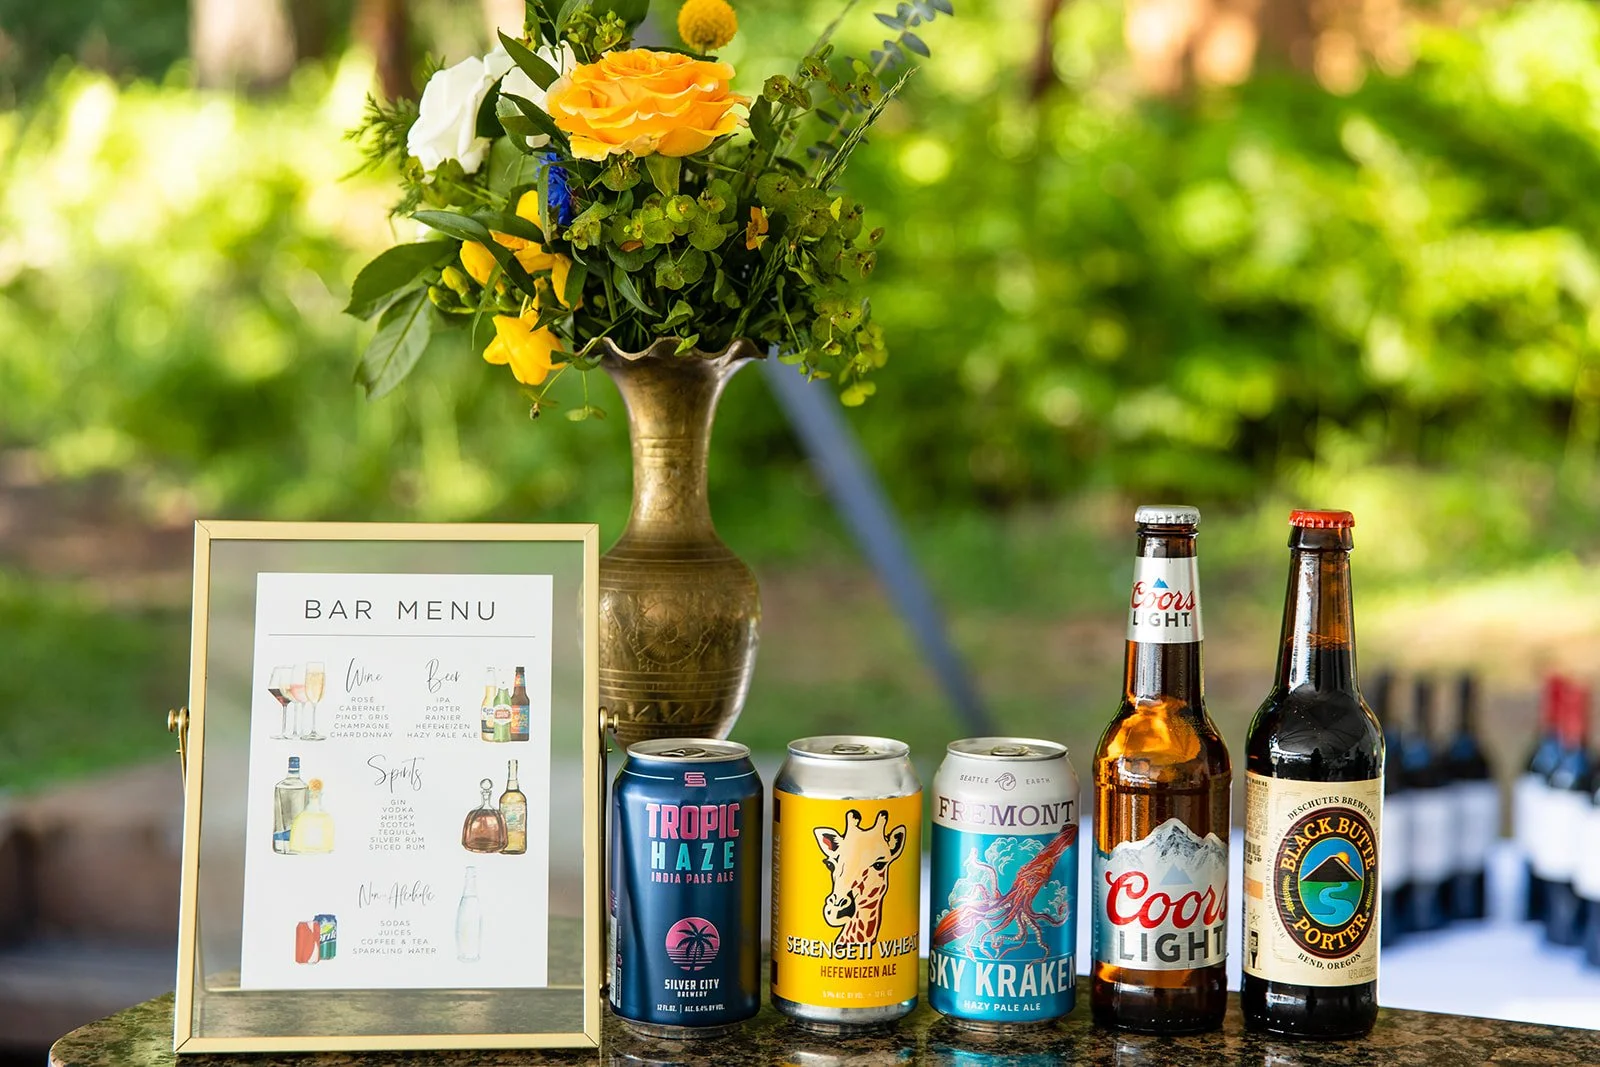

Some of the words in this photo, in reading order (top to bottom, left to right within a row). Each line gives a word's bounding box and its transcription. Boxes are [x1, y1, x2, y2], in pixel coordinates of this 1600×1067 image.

[304, 599, 373, 620] BAR
[397, 600, 496, 621] MENU
[1131, 581, 1196, 611] Coors
[1132, 611, 1191, 628] LIGHT
[345, 657, 383, 693] Wine
[425, 658, 461, 694] Beer
[367, 754, 425, 794] Spirits
[959, 774, 989, 784] SEATTLE
[645, 803, 741, 840] TROPIC
[938, 796, 1074, 827] FREMONT
[1287, 796, 1340, 821] DESCHUTES
[651, 841, 735, 871] HAZE
[1280, 817, 1335, 873] BLACK
[1335, 817, 1376, 871] BUTTE
[651, 872, 681, 884] INDIA
[686, 873, 712, 884] PALE
[717, 871, 734, 883] ALE
[1105, 871, 1227, 929] Coors
[786, 934, 873, 960] SERENGETI
[1119, 924, 1225, 963] LIGHT
[1292, 913, 1368, 951] PORTER
[352, 947, 403, 955] SPARKLING
[408, 947, 437, 955] WATER
[1297, 952, 1325, 970] BEND,
[1327, 952, 1362, 970] OREGON
[664, 979, 696, 990] SILVER
[699, 978, 720, 990] CITY
[820, 965, 880, 979] HEFEWEIZEN
[881, 963, 897, 977] ALE
[930, 950, 966, 993] SKY
[975, 952, 1076, 998] KRAKEN
[963, 1000, 990, 1010] HAZY
[994, 1003, 1020, 1012] PALE
[1023, 1002, 1041, 1012] ALE
